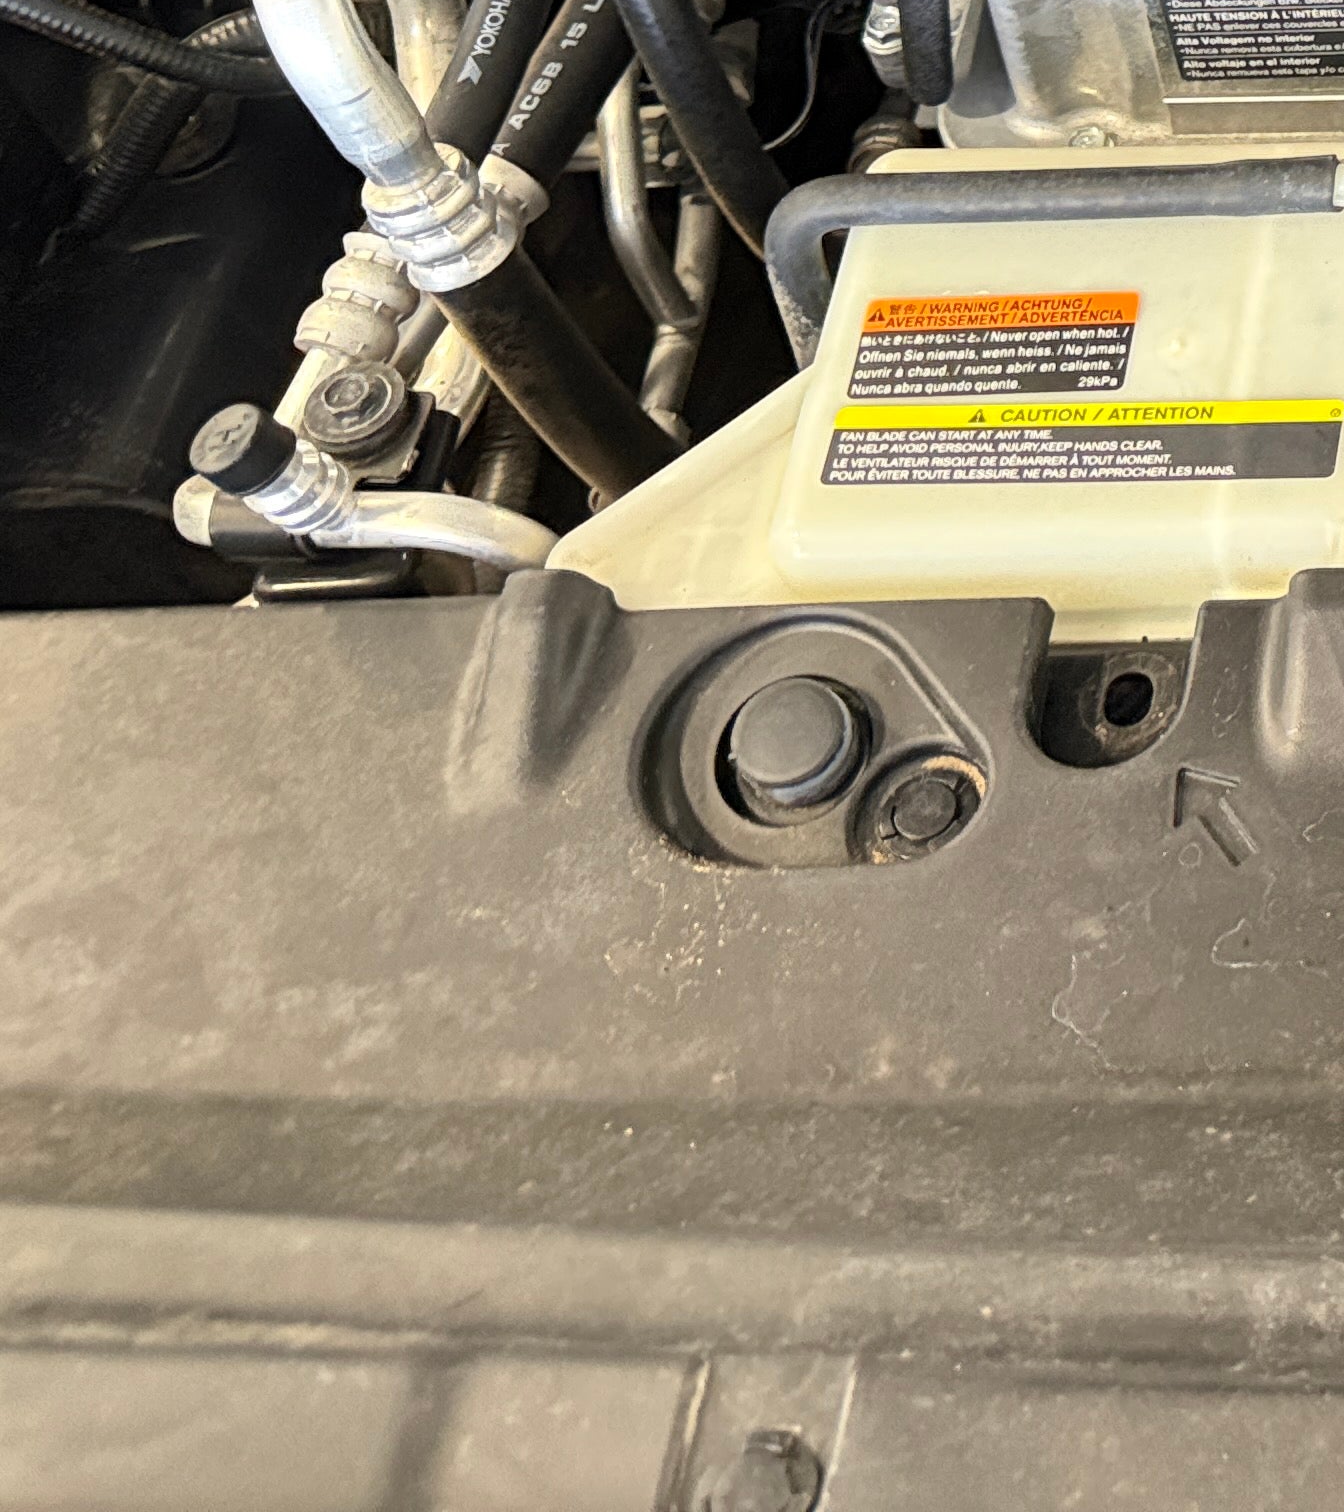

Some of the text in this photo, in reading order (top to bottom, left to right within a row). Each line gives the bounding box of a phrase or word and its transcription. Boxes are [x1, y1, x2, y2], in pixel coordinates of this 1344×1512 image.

[1168, 13, 1212, 23] HAUTE
[1213, 10, 1268, 22] TENSION
[1271, 9, 1280, 20] À
[1196, 22, 1222, 32] PAS
[1275, 33, 1315, 43] interior
[1280, 57, 1321, 66] interior
[508, 62, 564, 131] AC6B
[560, 22, 588, 50] 15
[929, 301, 1000, 315] WARNING
[1009, 298, 1084, 312] ACHTUNG
[884, 309, 1124, 328] AVERTISSEMENT ADVERTENCIA
[990, 330, 1028, 343] Never
[1029, 330, 1061, 343] open
[1061, 328, 1096, 340] when
[1096, 327, 1120, 339] hot.
[903, 349, 925, 362] Sie
[982, 347, 1016, 359] wenn
[1064, 343, 1083, 356] Ne
[1083, 342, 1127, 357] jamais
[854, 366, 893, 380] ouvrir
[907, 364, 950, 377] chaud.
[963, 364, 1003, 376] nunca
[1005, 361, 1037, 374] abrir
[1040, 362, 1057, 373] en
[1059, 359, 1114, 372] caliente.
[850, 375, 1119, 395] Nunca abra quando quente. 29kPa
[1000, 407, 1087, 423] CAUTION
[1107, 405, 1214, 421] ATTENTION
[839, 431, 865, 442] FAN
[867, 431, 907, 442] BLADE
[908, 431, 937, 441] CAN
[938, 430, 978, 441] START
[977, 430, 996, 440] AT
[995, 429, 1022, 440] ANY
[837, 444, 855, 454] TO
[856, 443, 889, 454] HELP
[890, 443, 928, 454] AVOID
[929, 442, 995, 453] PERSONAL
[1074, 440, 1118, 452] HANDS
[1120, 440, 1163, 451] CLEAR.
[833, 453, 1172, 469] LE VENTILATEUR RISQUE DE DÉMARRER À TOUT MOMENT.
[829, 470, 866, 481] POUR
[867, 468, 909, 481] ÉVITER
[911, 470, 952, 480] TOUTE
[1023, 468, 1041, 479] NE
[1042, 468, 1068, 479] PAS
[1070, 467, 1089, 478] EN
[1089, 466, 1168, 478] APPROCHER
[1169, 465, 1193, 477] LES
[1195, 465, 1236, 476] MAINS.
